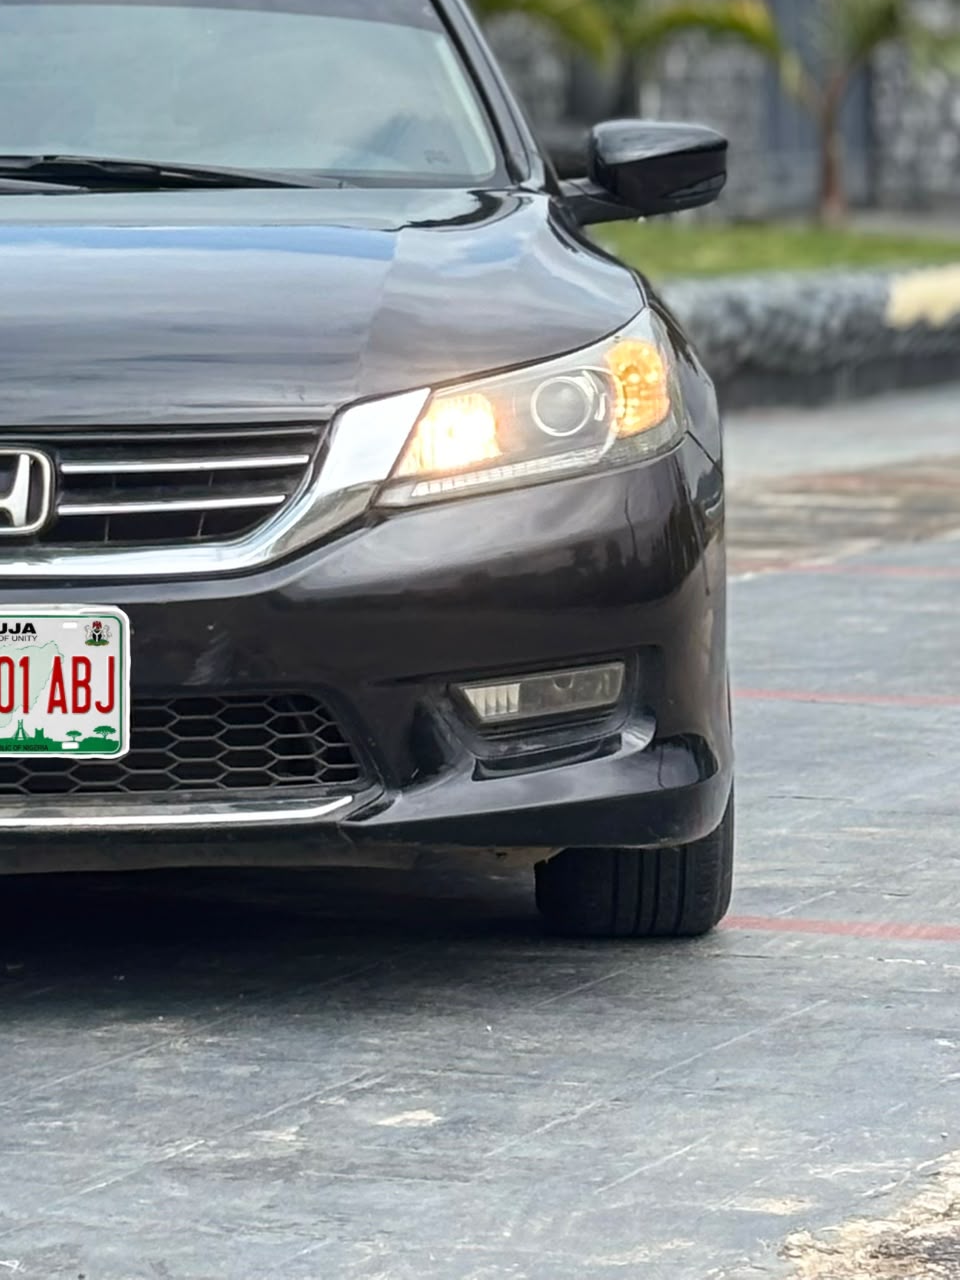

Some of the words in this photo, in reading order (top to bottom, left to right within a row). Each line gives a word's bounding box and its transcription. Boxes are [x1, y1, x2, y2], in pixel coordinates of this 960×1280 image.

[11, 634, 38, 642] UNITY
[47, 656, 115, 714] ABJ
[12, 744, 22, 752] OF
[23, 744, 49, 752] NIGERIA
